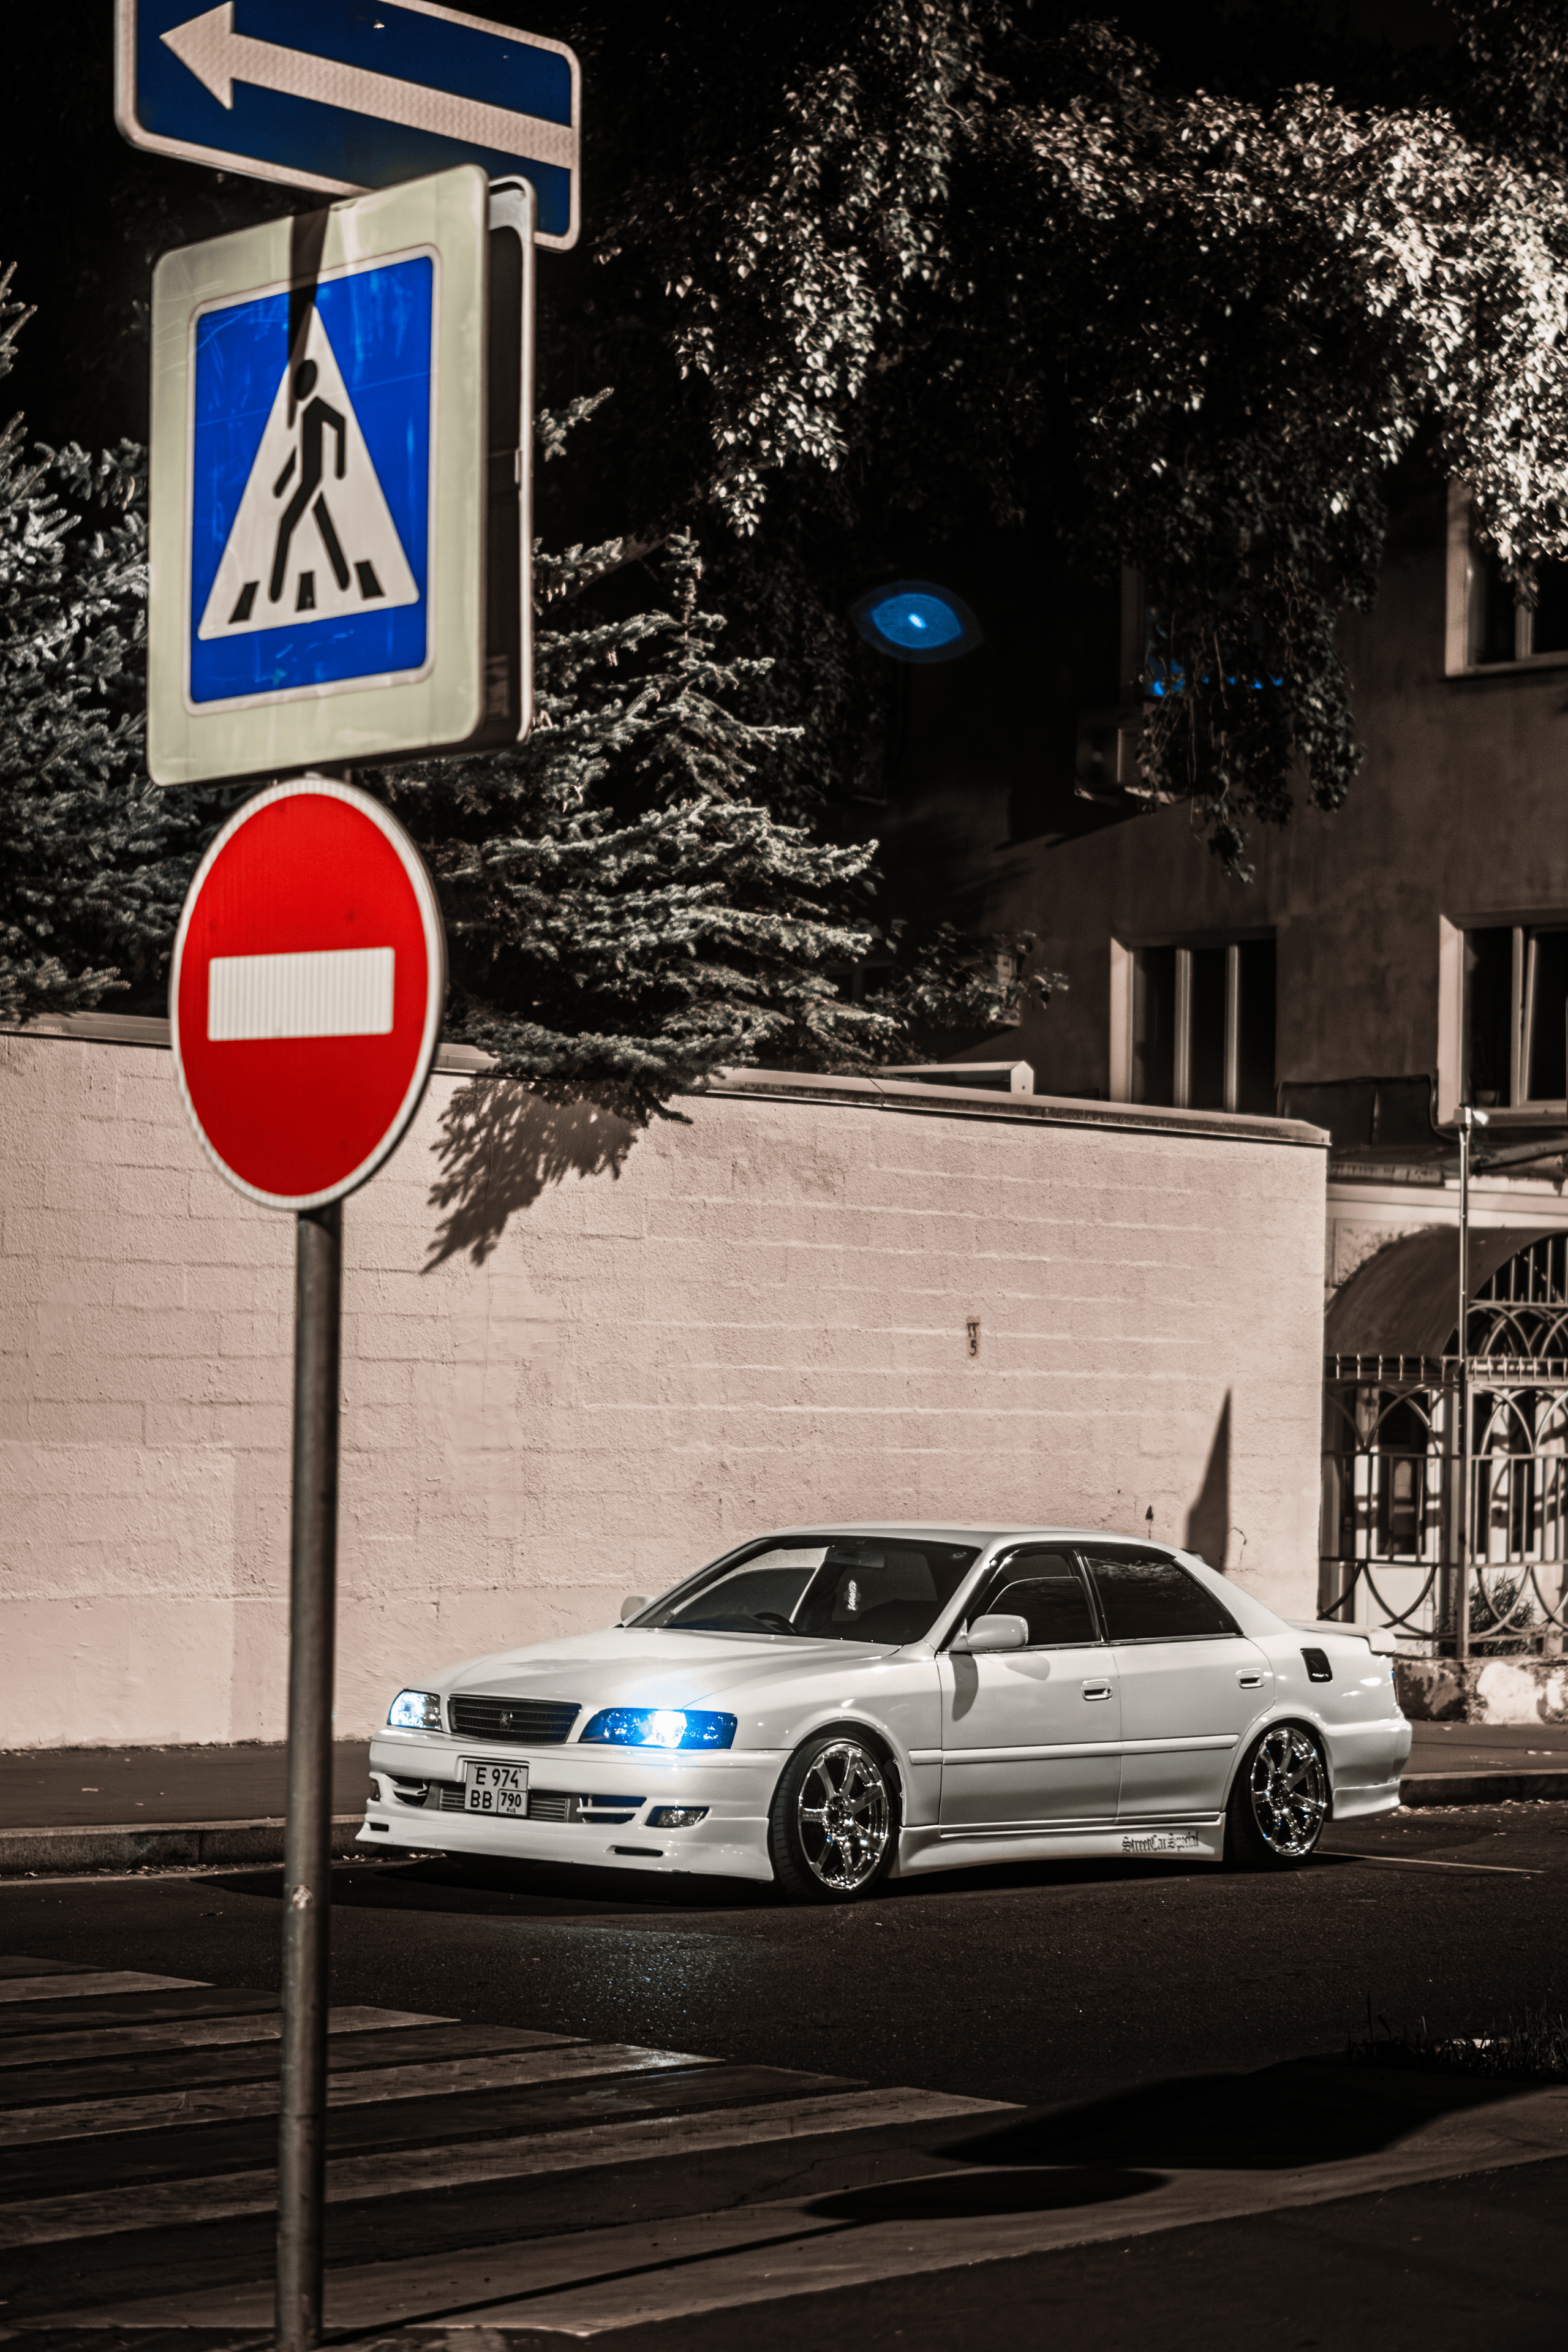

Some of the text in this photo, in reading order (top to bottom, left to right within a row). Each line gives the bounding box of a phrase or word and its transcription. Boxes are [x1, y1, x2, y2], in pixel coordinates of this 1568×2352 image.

[476, 1766, 518, 1788] E 974
[470, 1789, 522, 1809] BB 790
